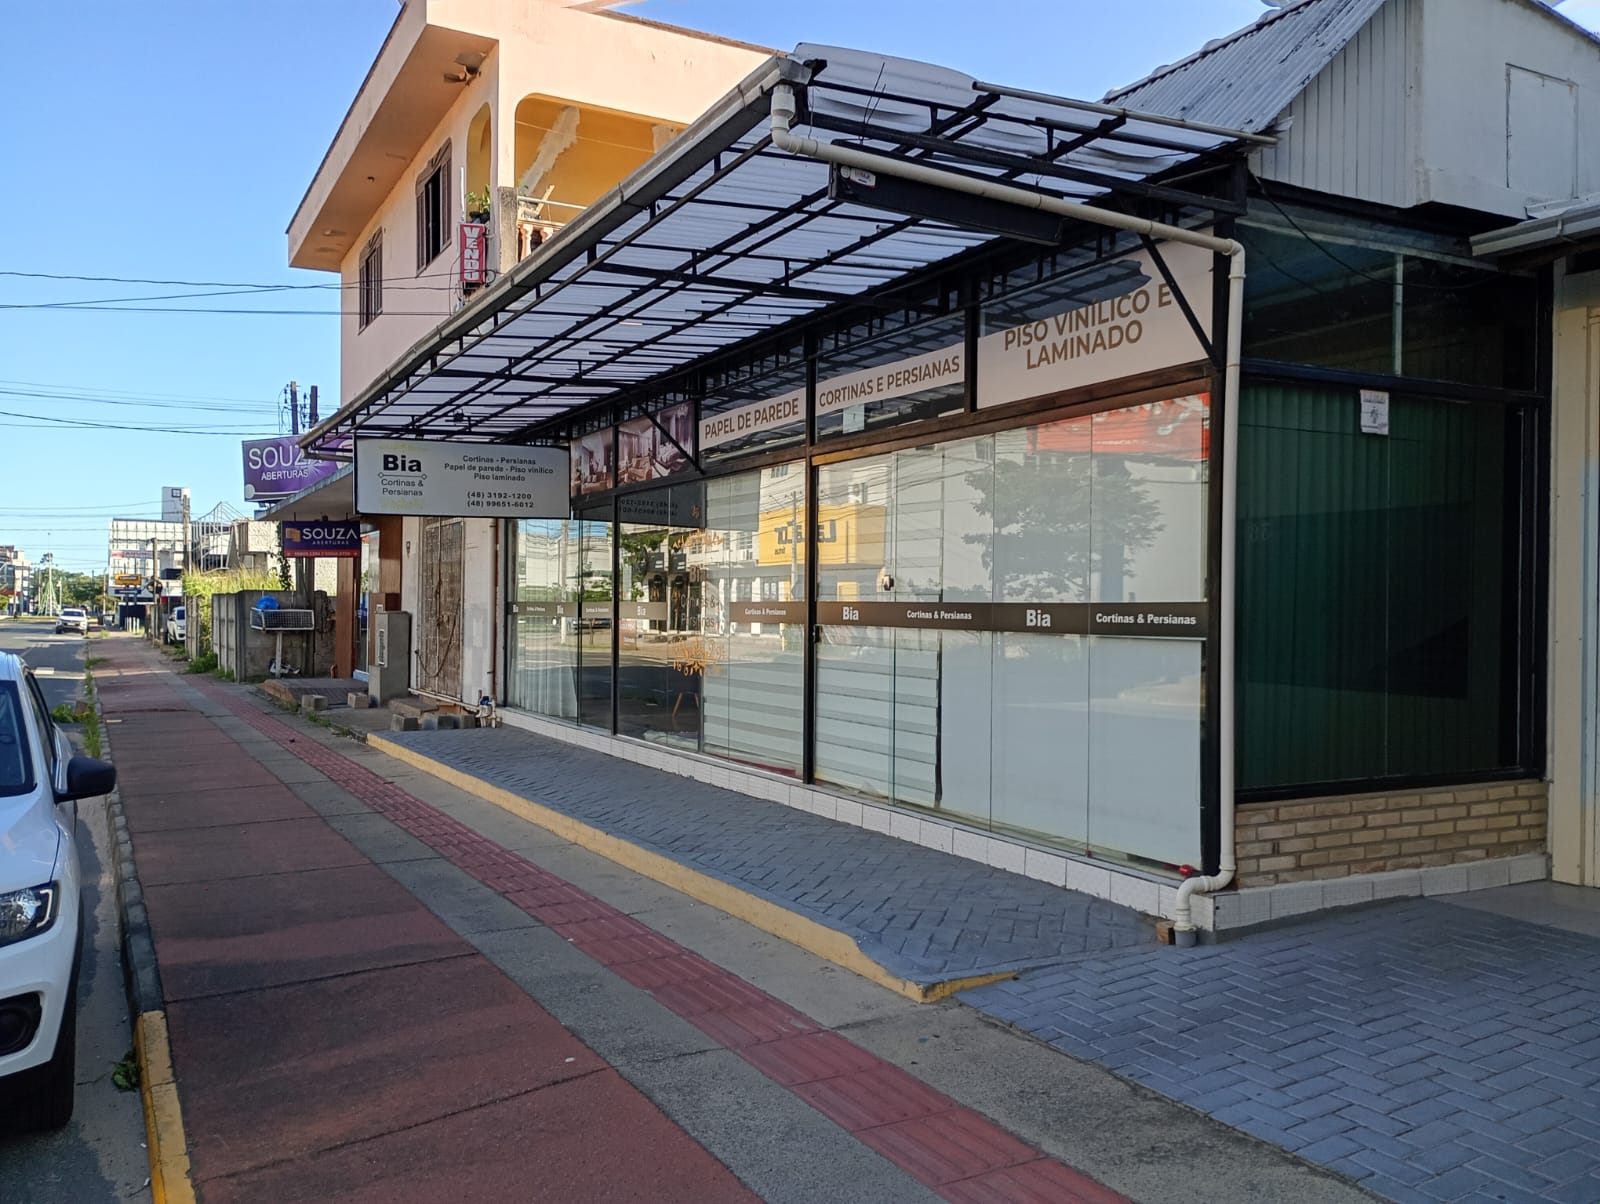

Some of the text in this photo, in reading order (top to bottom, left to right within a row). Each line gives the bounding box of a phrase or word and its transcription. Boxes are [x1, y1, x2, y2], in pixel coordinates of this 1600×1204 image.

[1005, 321, 1048, 351] PISO
[1158, 283, 1172, 308] E
[1026, 320, 1143, 370] LAMINADO
[819, 355, 961, 408] CORTINAS E PERSIANAS
[704, 397, 799, 440] PAPEL DE PAREDE
[383, 454, 422, 472] Bia
[463, 455, 494, 463] Cortinas
[500, 457, 536, 465] Persianas
[444, 463, 466, 471] Papel
[261, 469, 309, 481] ABERTURAS
[473, 472, 526, 481] Piso laminado
[381, 478, 424, 488] Cortinas &
[382, 487, 424, 496] Persianas
[467, 491, 485, 499] (48)
[467, 500, 485, 508] (48)
[302, 527, 358, 540] SOUZA
[842, 606, 859, 621] Bia
[906, 610, 972, 620] Cortinas & Persianas
[1025, 609, 1051, 627] Bia
[1095, 613, 1197, 625] Cortinas & Persianas
